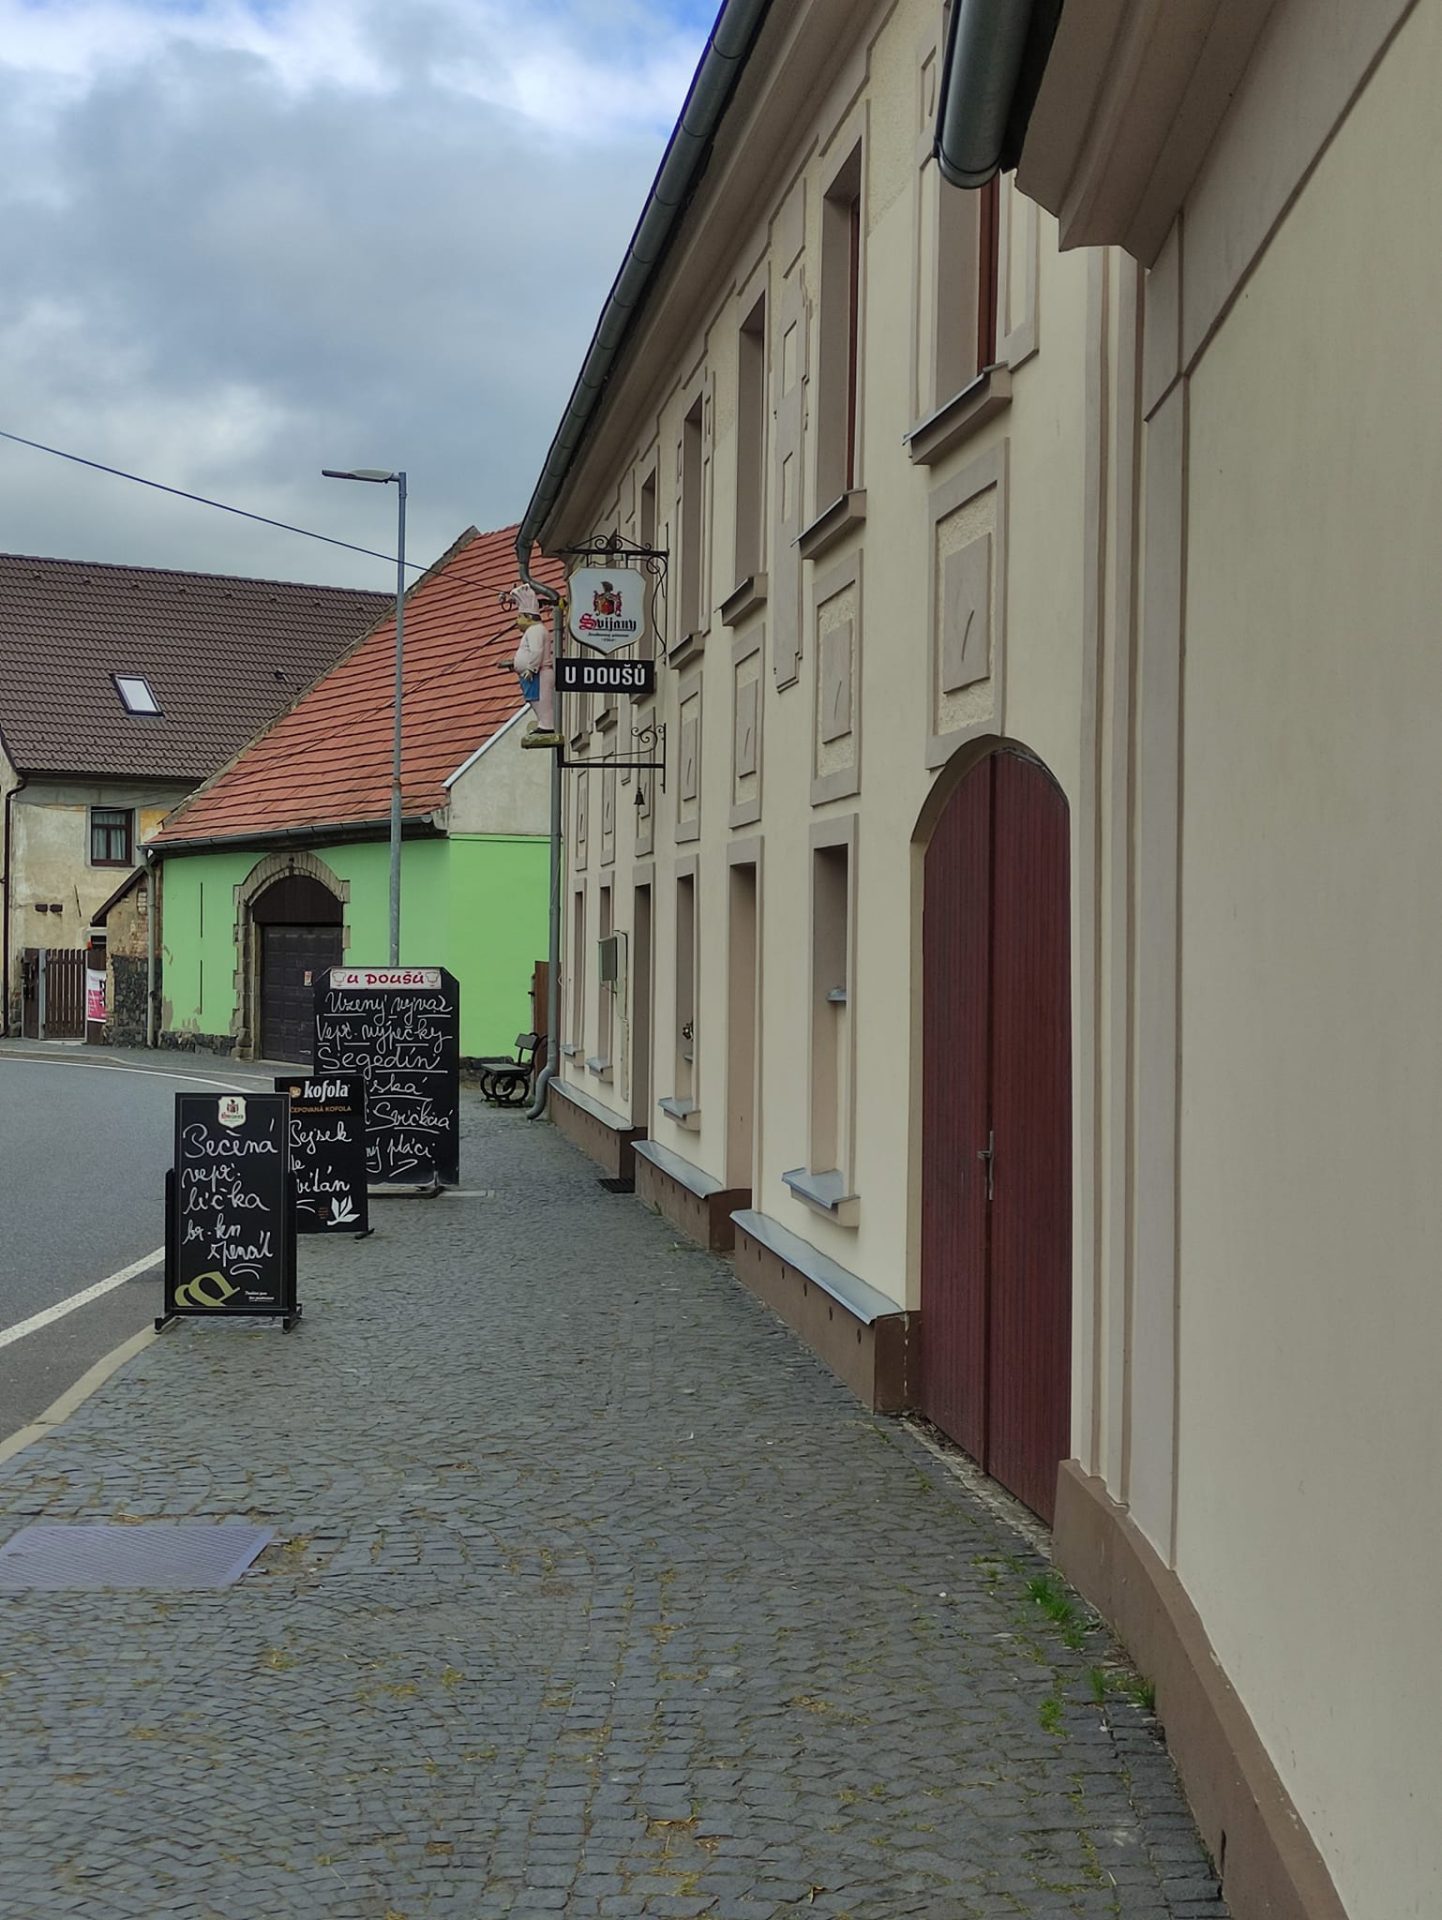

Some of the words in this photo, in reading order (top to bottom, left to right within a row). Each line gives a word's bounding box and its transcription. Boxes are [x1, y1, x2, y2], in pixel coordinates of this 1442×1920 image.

[579, 613, 637, 631] Svijany
[565, 666, 576, 684] U
[583, 664, 646, 686] DOUŠŮ
[304, 1079, 350, 1103] kofola
